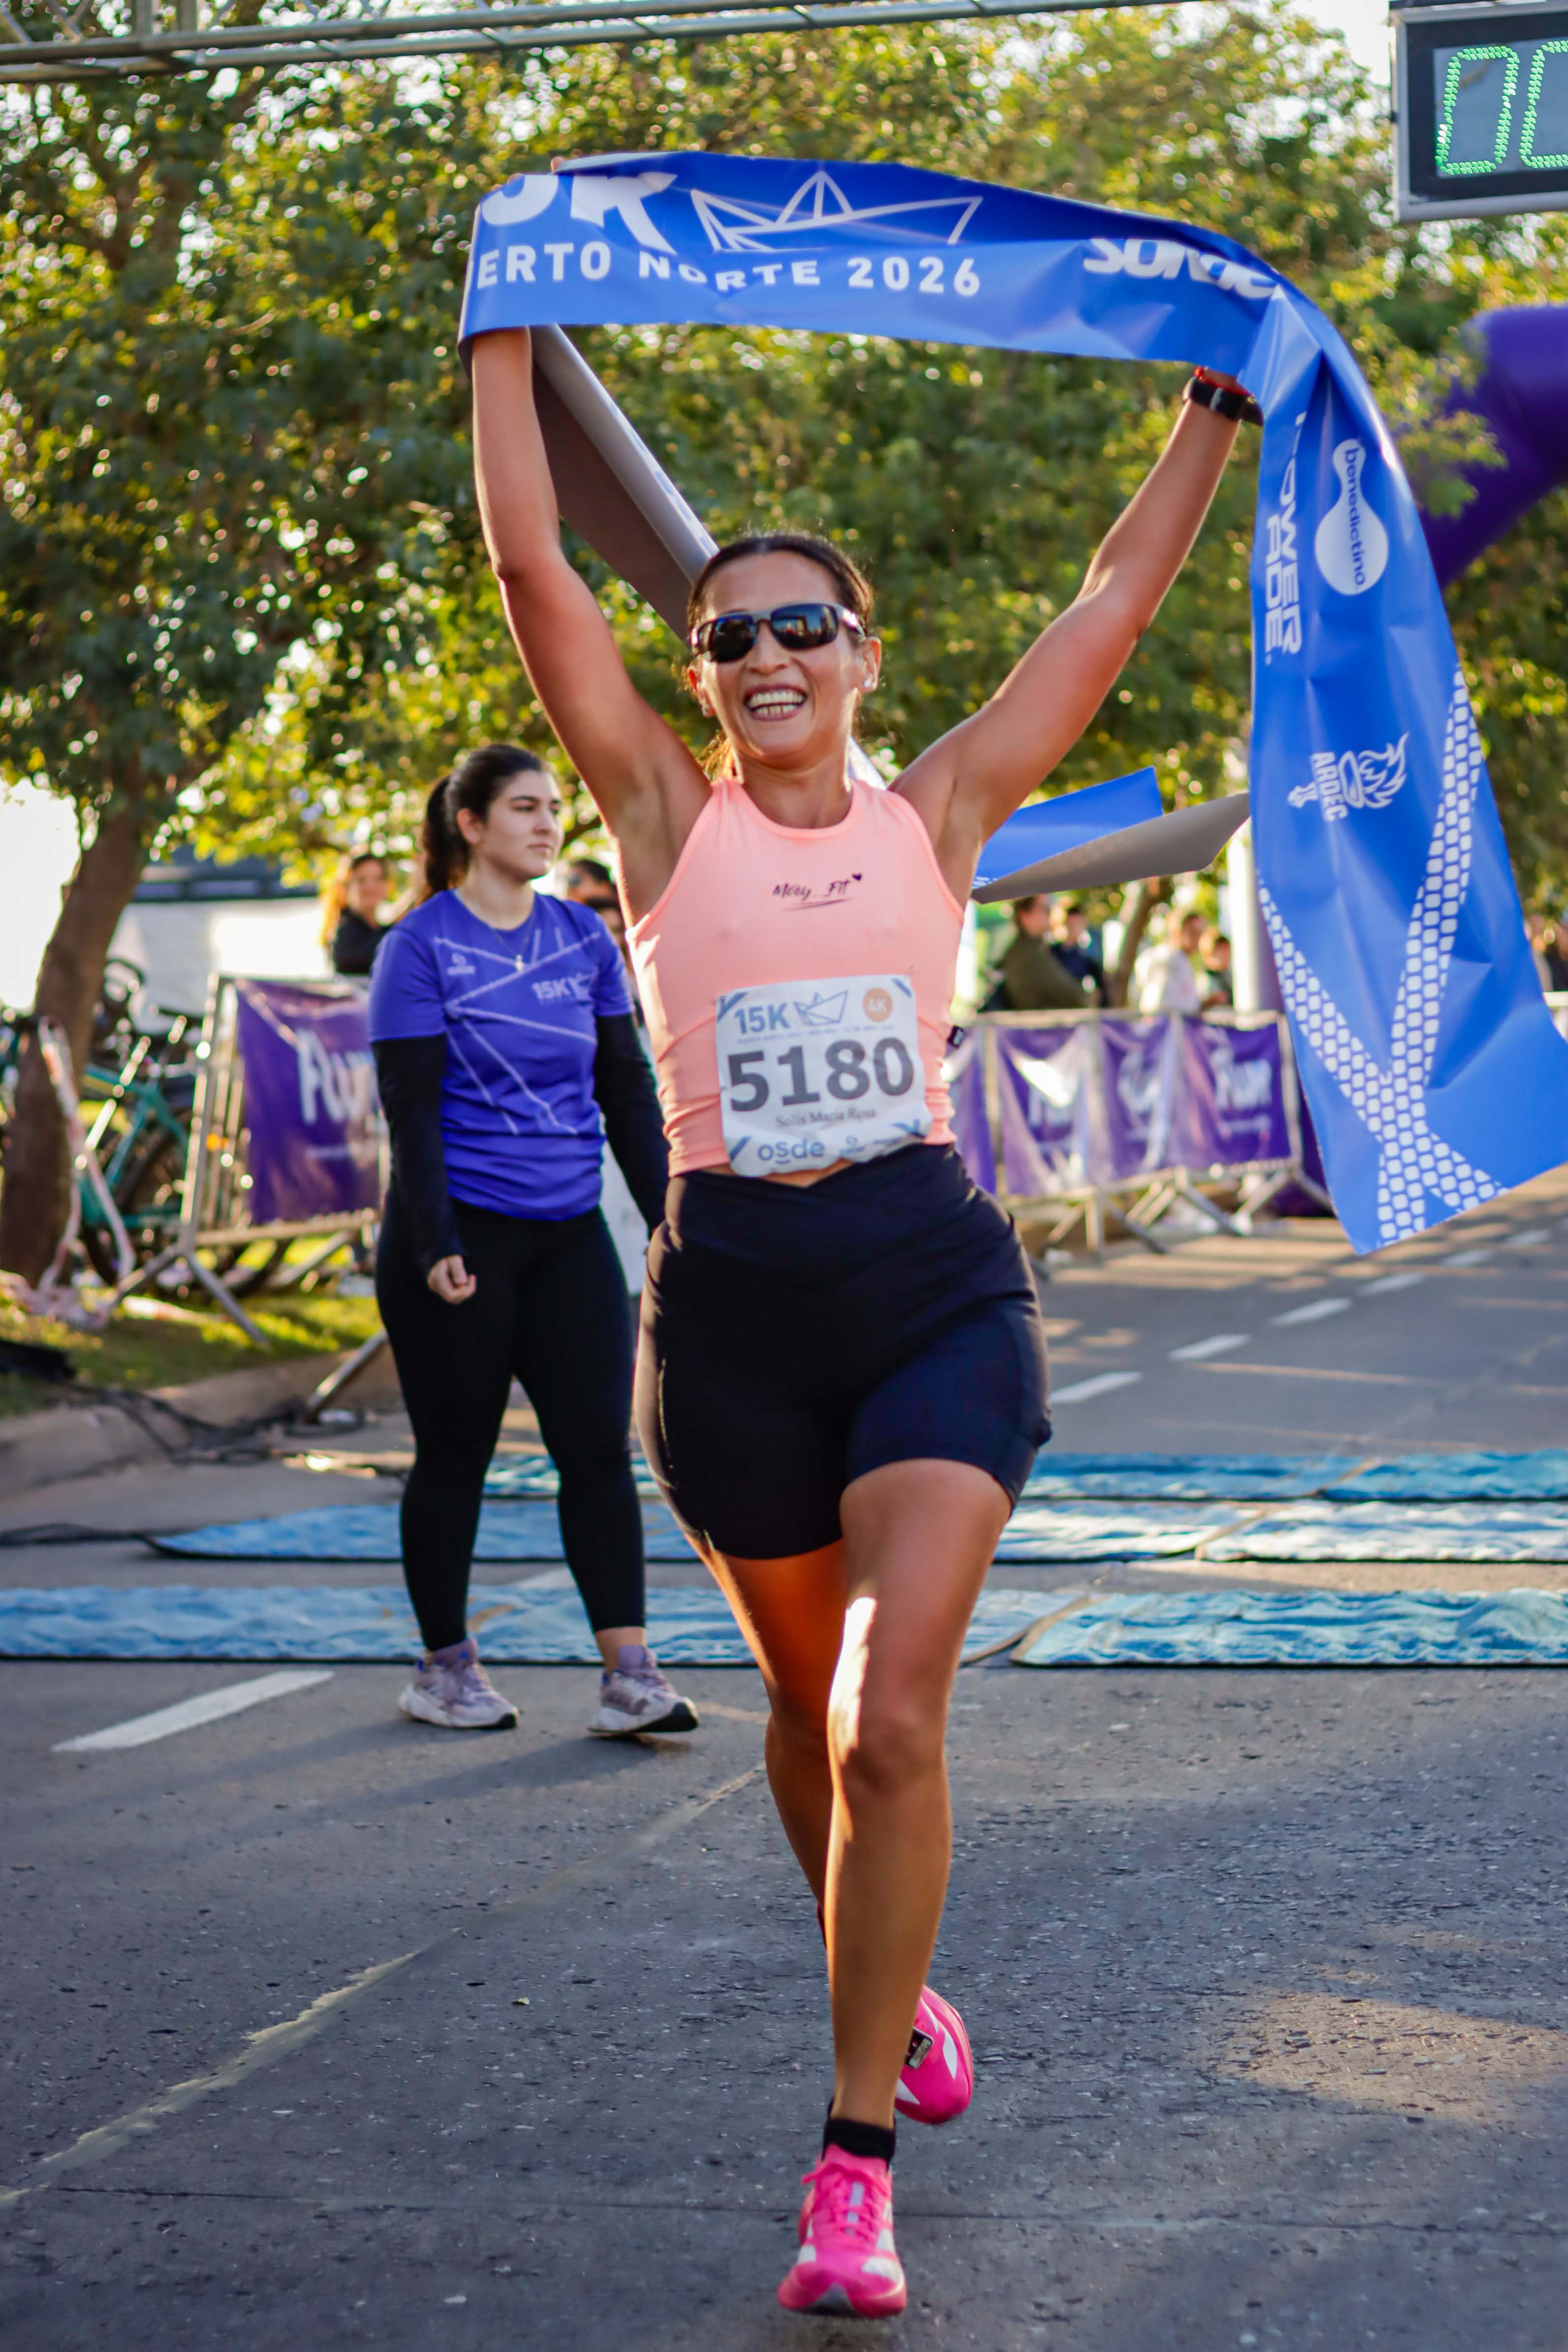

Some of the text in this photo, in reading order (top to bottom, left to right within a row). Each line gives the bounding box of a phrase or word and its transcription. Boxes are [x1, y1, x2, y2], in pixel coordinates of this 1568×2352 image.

[639, 251, 821, 292] NORTE
[847, 256, 980, 296] 2026
[1280, 411, 1306, 654] OWER
[1344, 448, 1366, 586] benedictino
[1310, 751, 1348, 822] ARDEC
[734, 1002, 790, 1034] 15K
[728, 1036, 914, 1112] 5180
[758, 1138, 825, 1164] osde
